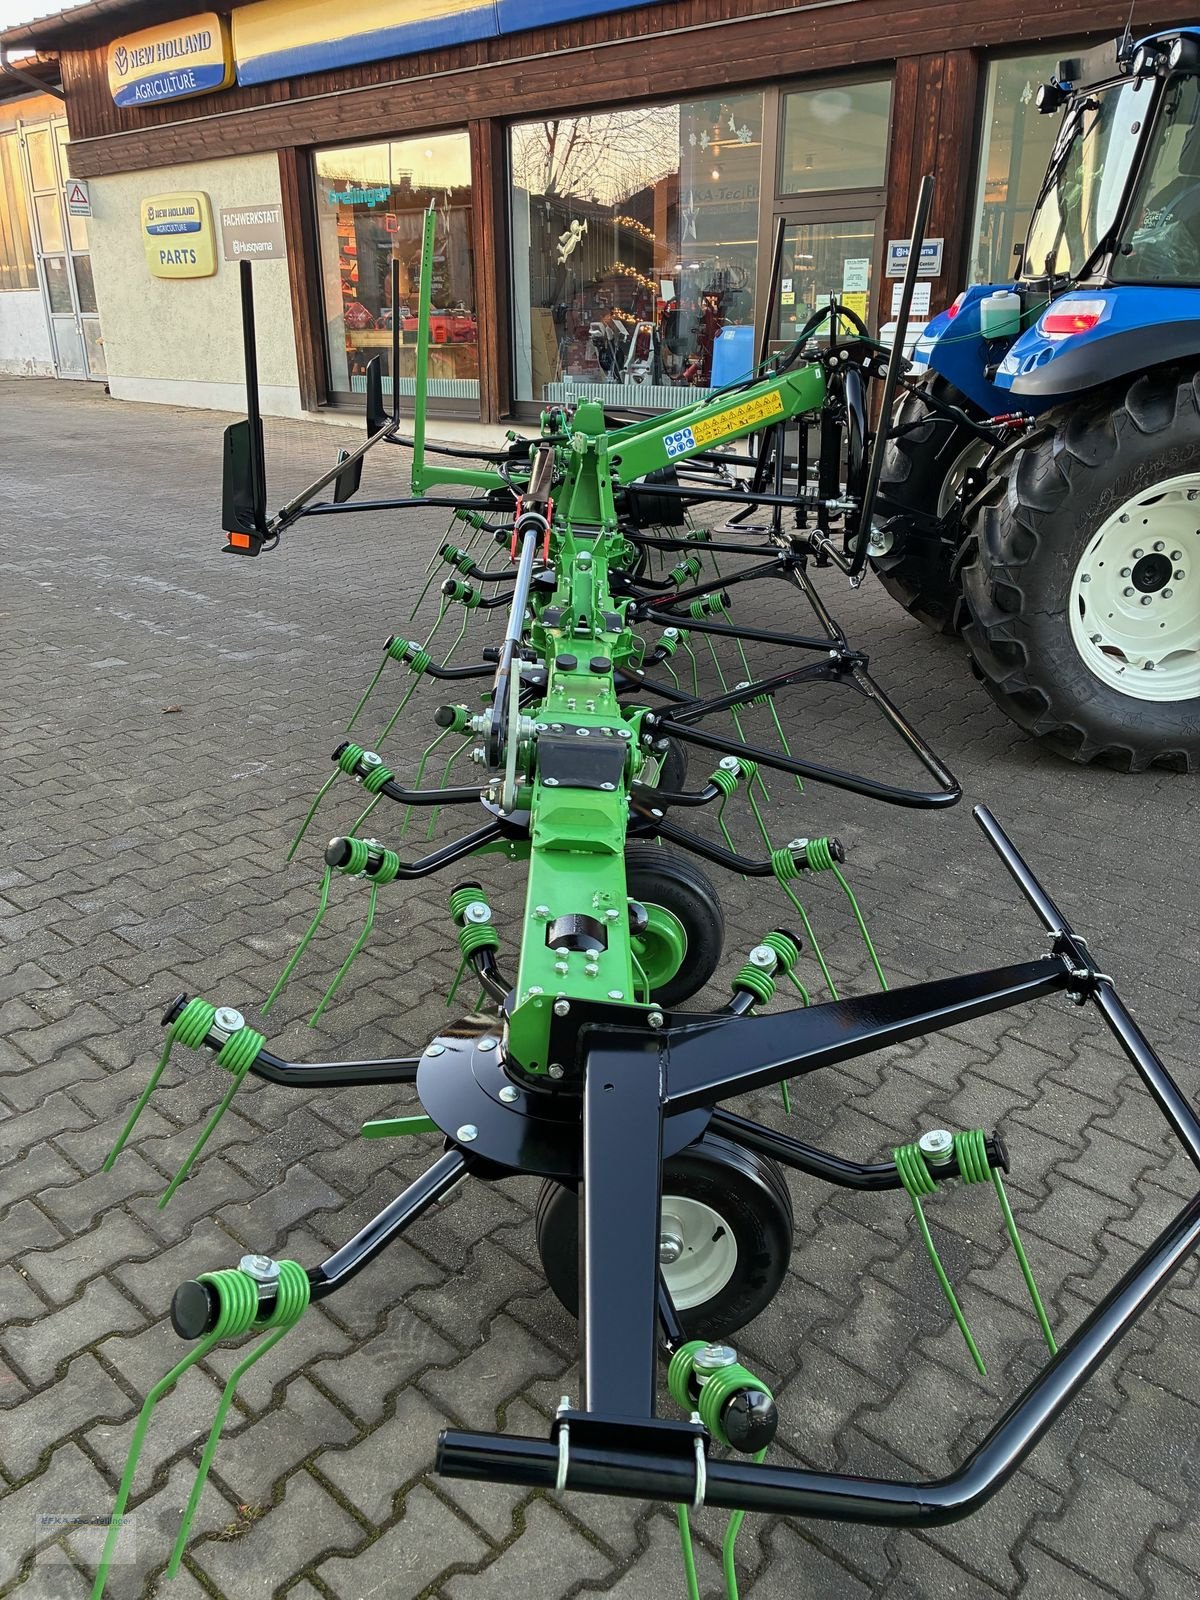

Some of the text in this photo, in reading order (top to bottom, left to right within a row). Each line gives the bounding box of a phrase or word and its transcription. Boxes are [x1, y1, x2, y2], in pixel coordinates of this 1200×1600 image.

[129, 31, 212, 69] NEW HOLLAND
[135, 72, 196, 100] AGRICULTURE
[155, 206, 195, 219] NEW HOLLAND
[223, 210, 280, 227] FACHWERKSTATT
[156, 223, 188, 233] AGRICULTURE
[239, 241, 273, 254] Husqvarna
[159, 249, 197, 265] PARTS
